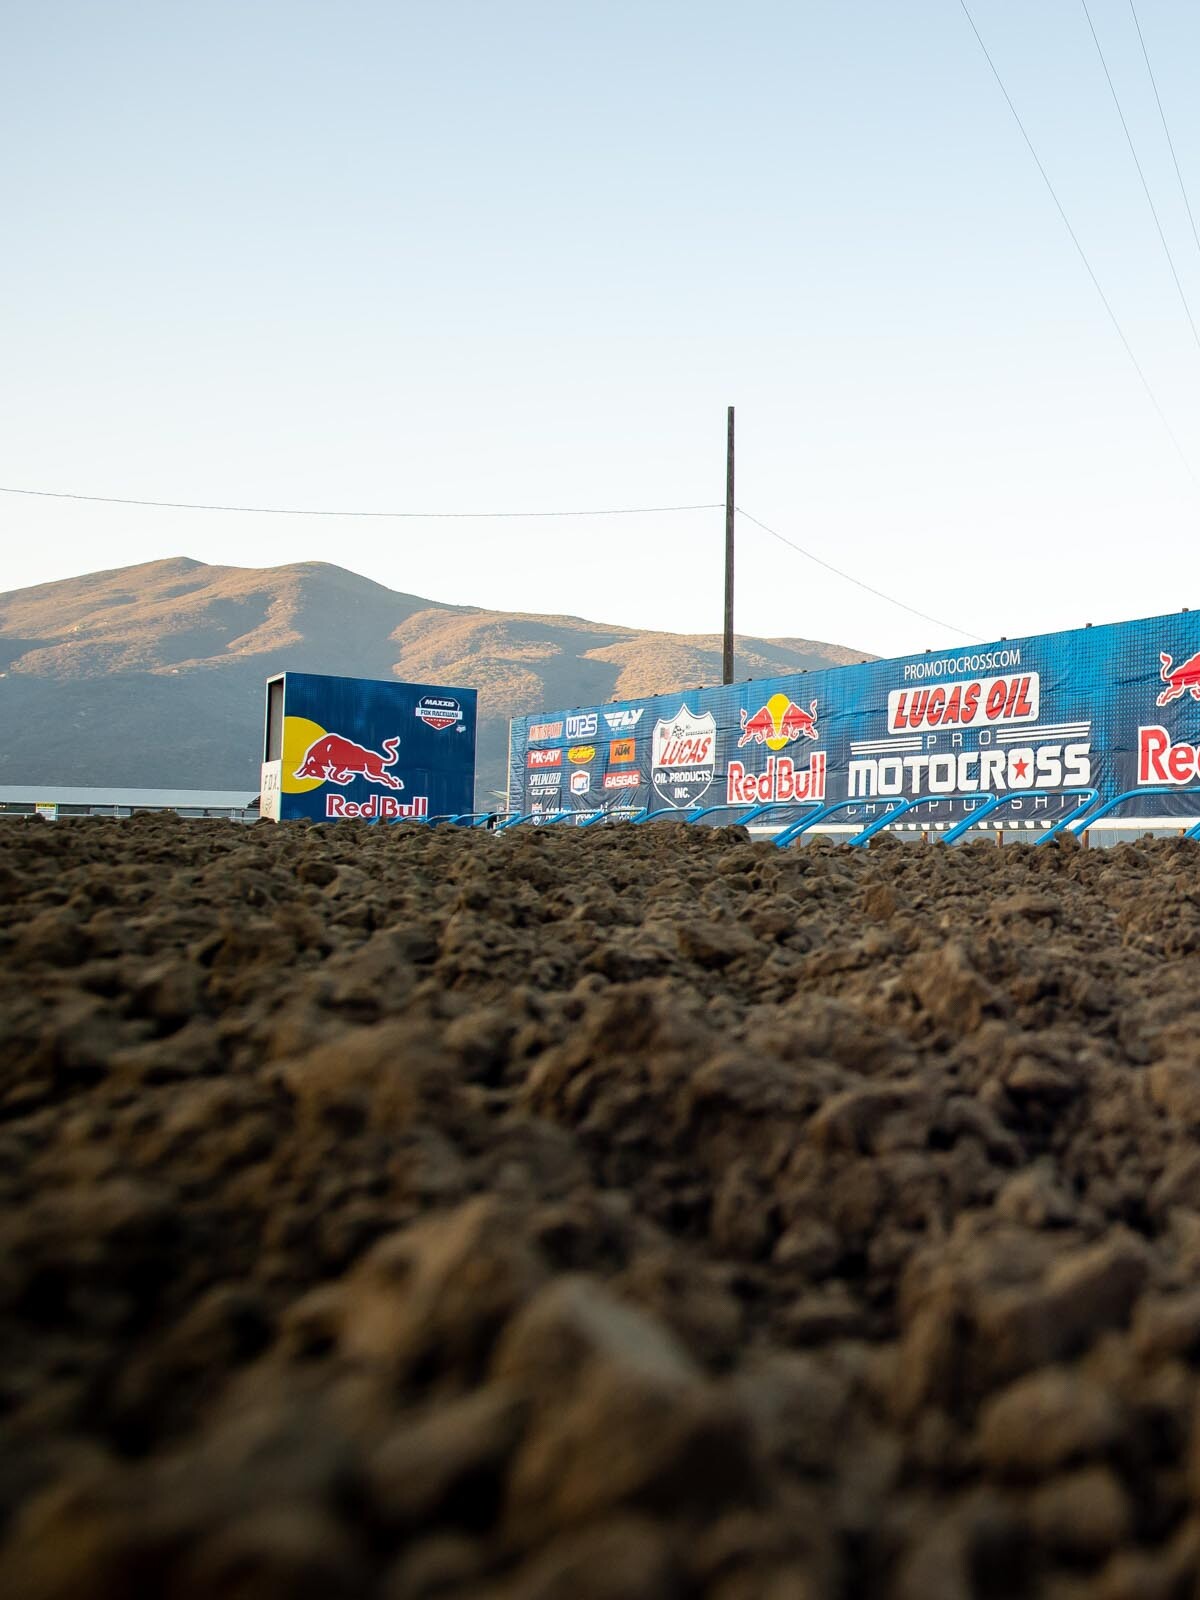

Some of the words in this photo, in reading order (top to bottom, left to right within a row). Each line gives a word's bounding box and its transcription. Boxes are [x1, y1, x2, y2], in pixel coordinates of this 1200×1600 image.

[904, 649, 1021, 680] PROMOTOCROSS.COM
[893, 683, 982, 729] LUCAS
[985, 676, 1033, 720] OIL
[567, 714, 597, 738] WPS
[603, 709, 644, 727] FLY
[926, 730, 992, 749] PRO
[659, 737, 711, 765] LUCAS
[605, 775, 639, 788] GASGAS
[654, 773, 668, 784] OIL
[669, 770, 711, 783] PRODUCTS
[727, 753, 774, 803] Red
[775, 751, 826, 802] Bull
[848, 743, 1092, 798] MOTOCROSS
[674, 787, 690, 798] INC.
[327, 795, 378, 817] Red
[380, 797, 428, 817] Bull
[847, 794, 1092, 815] CHAMPIOSHIP
